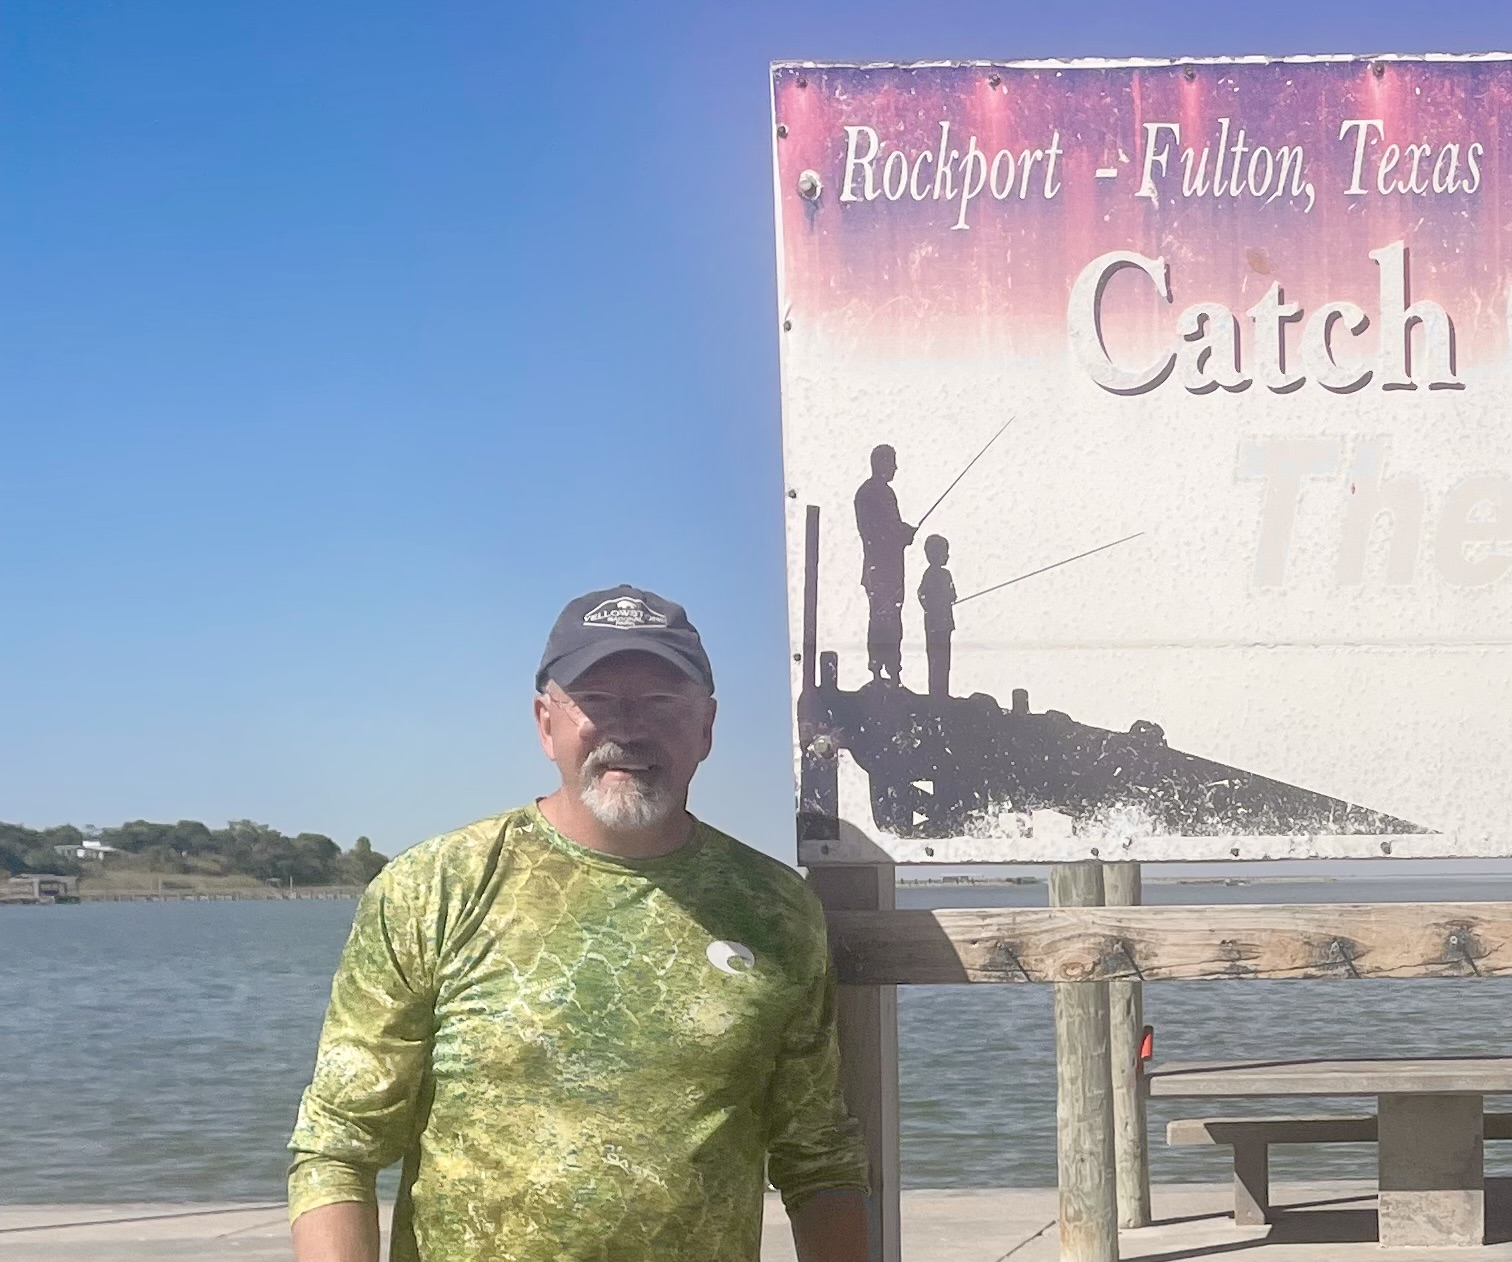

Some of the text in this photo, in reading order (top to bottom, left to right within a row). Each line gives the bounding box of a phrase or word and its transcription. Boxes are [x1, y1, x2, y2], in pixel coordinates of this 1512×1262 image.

[840, 120, 1063, 230] Rockport
[1135, 119, 1317, 214] Fulton,
[1338, 117, 1485, 196] Texas
[1067, 238, 1467, 396] Catch
